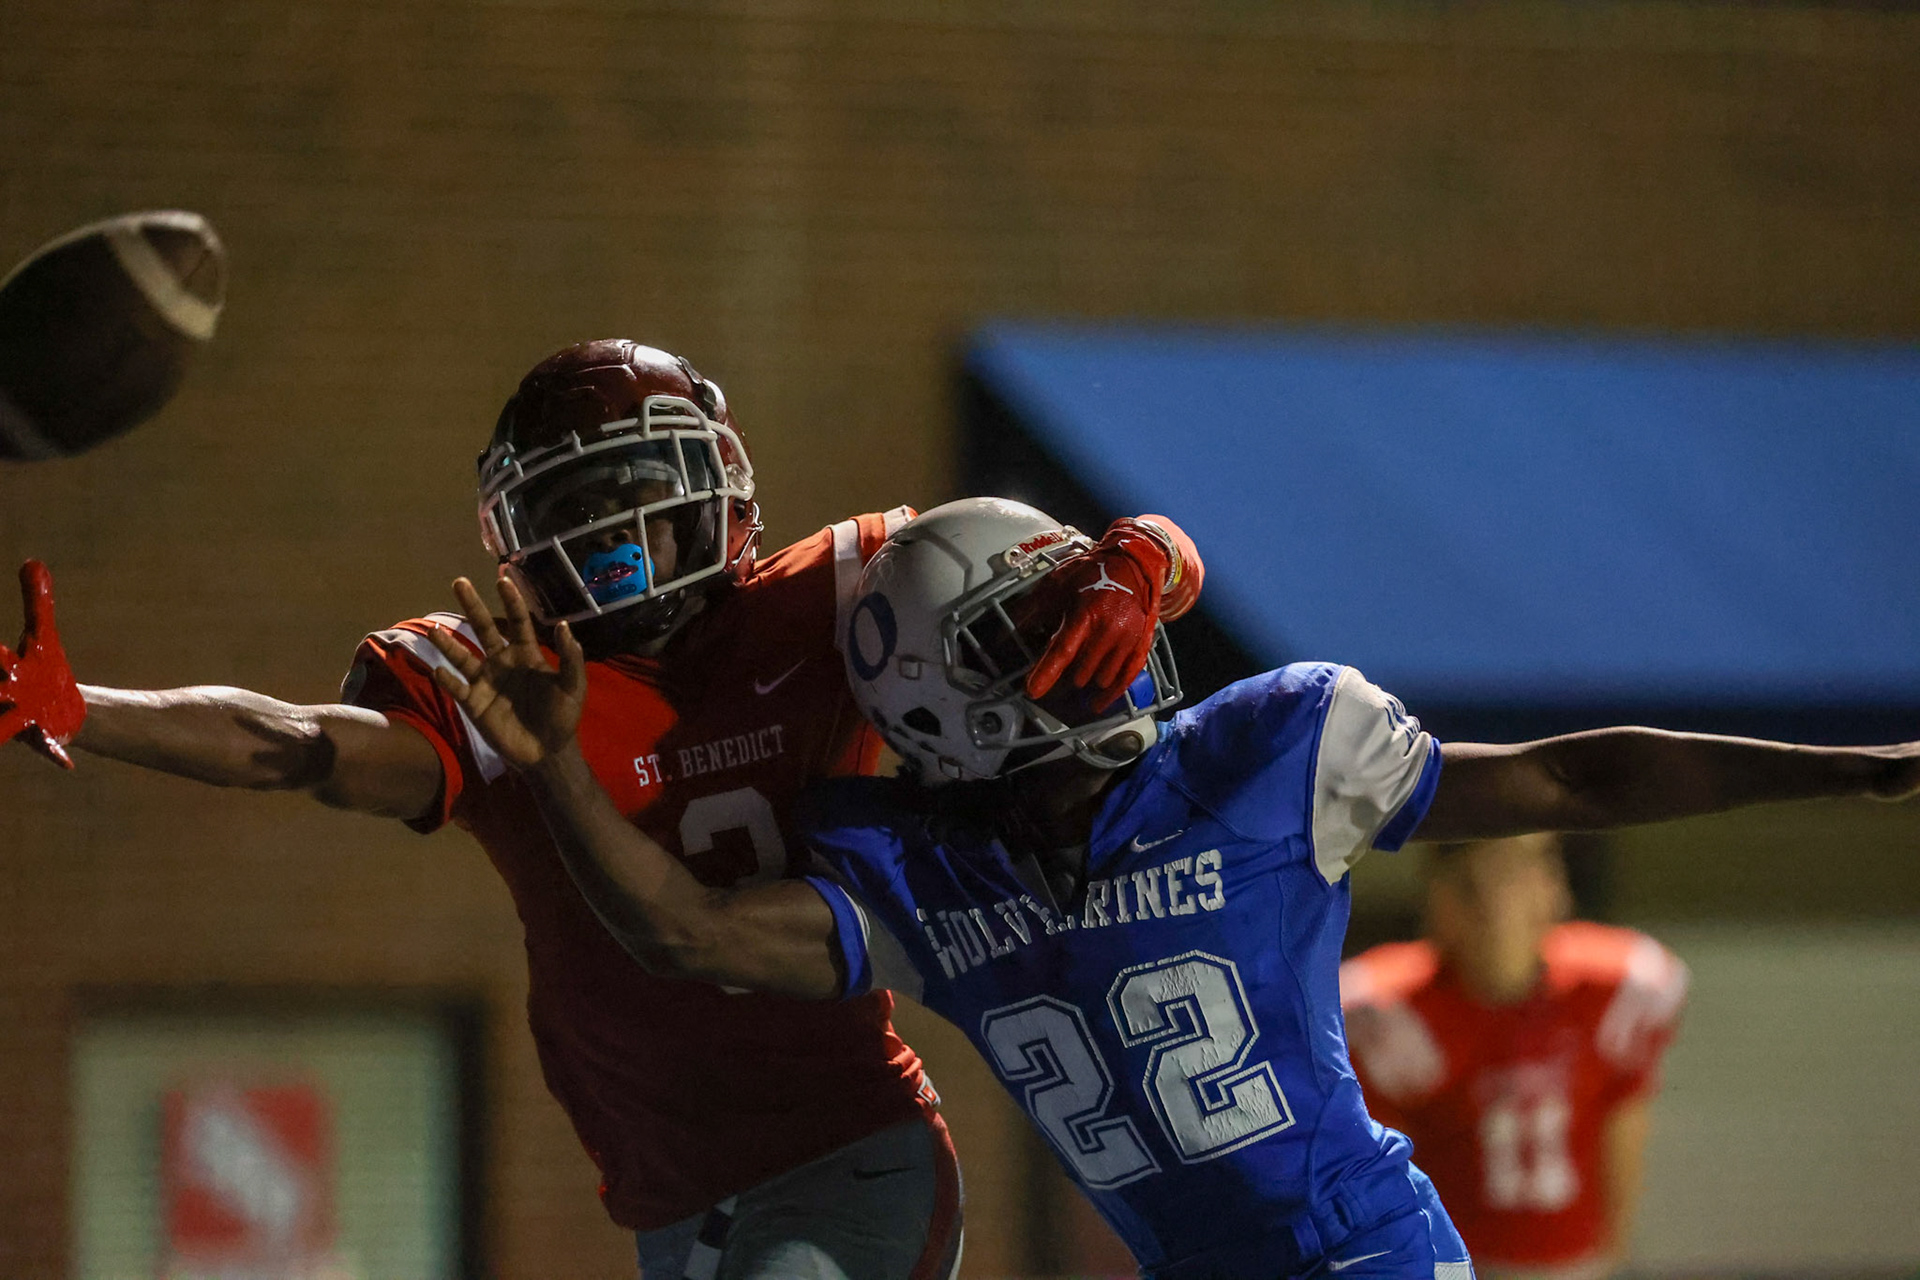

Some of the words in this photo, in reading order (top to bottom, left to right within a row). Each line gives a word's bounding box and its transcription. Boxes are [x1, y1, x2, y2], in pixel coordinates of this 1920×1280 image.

[633, 754, 673, 788] ST.
[677, 724, 784, 779] BENEDICT
[979, 948, 1297, 1191] 22
